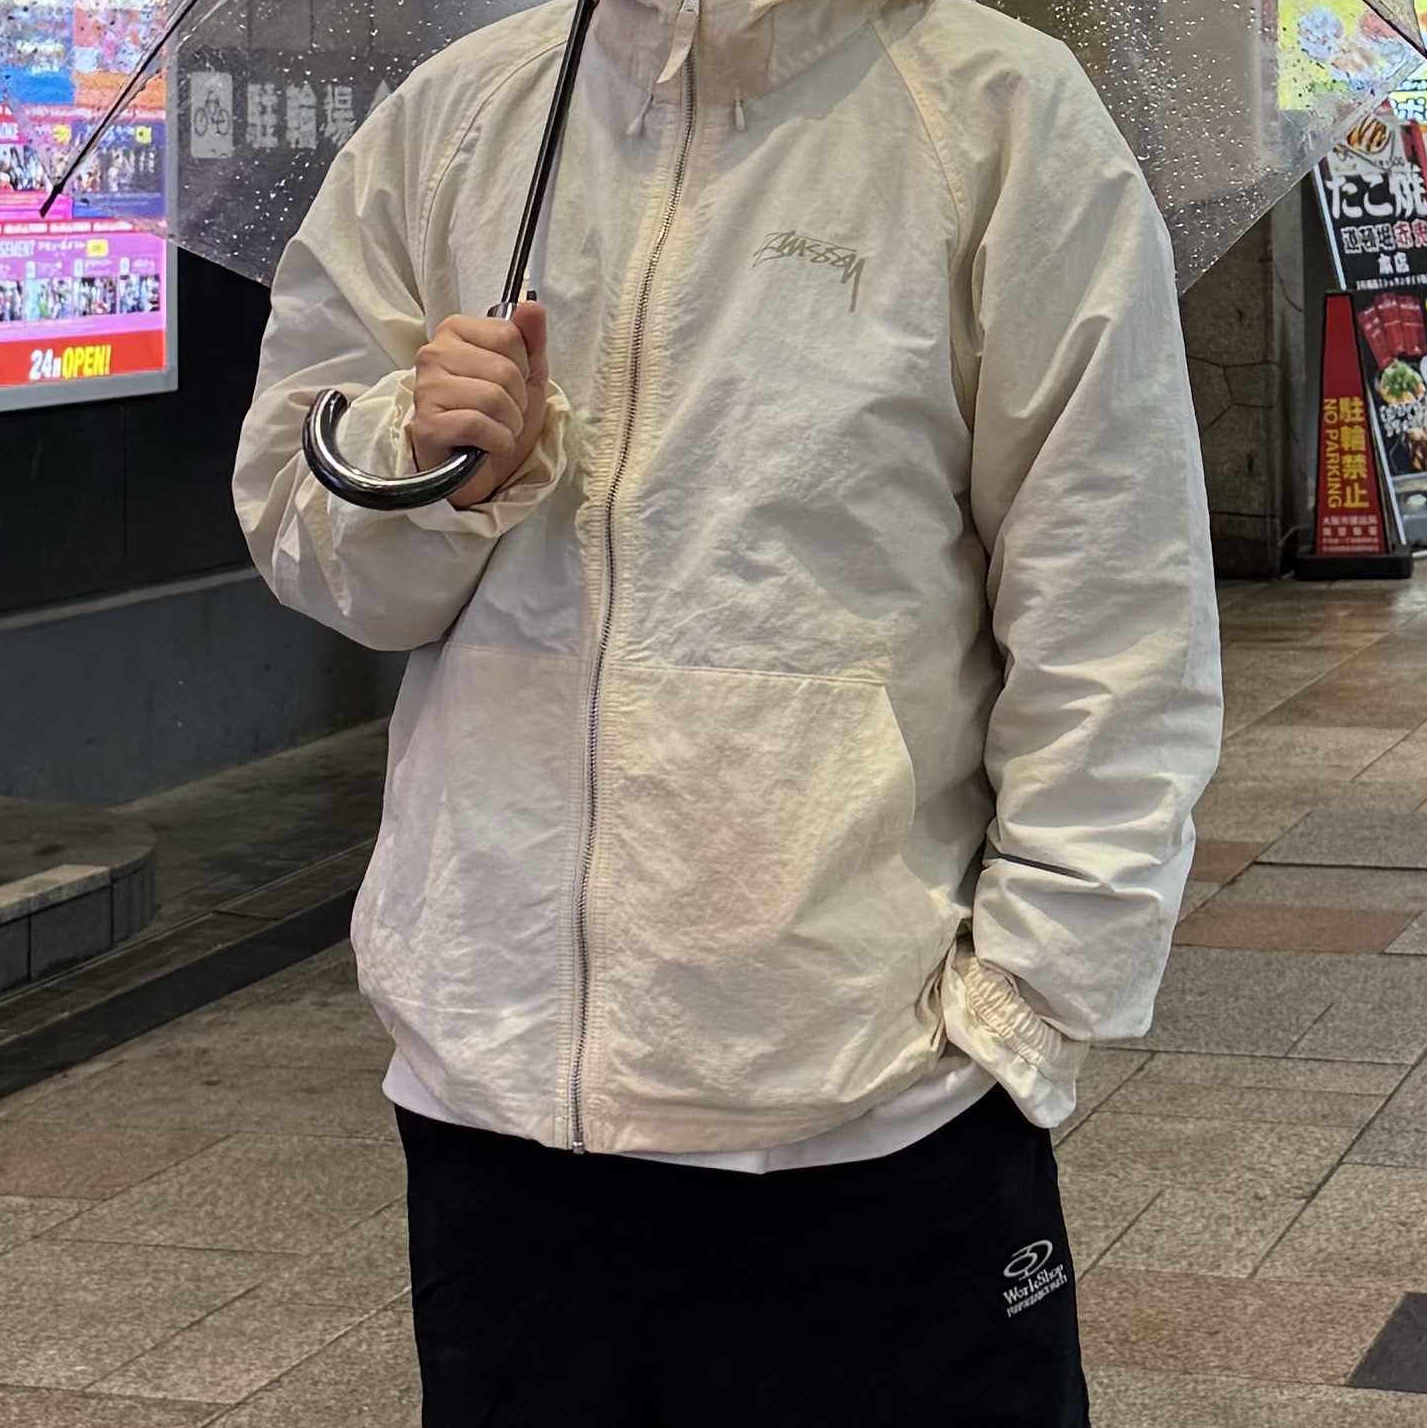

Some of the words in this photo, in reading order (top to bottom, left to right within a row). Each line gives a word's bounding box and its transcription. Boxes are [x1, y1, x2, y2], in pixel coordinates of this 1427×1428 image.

[61, 344, 112, 379] OPEN!
[1323, 398, 1339, 425] NO
[1325, 428, 1343, 509] PARKING
[1338, 396, 1370, 508] 駐輪禁止
[1002, 1263, 1065, 1306] WorkShop
